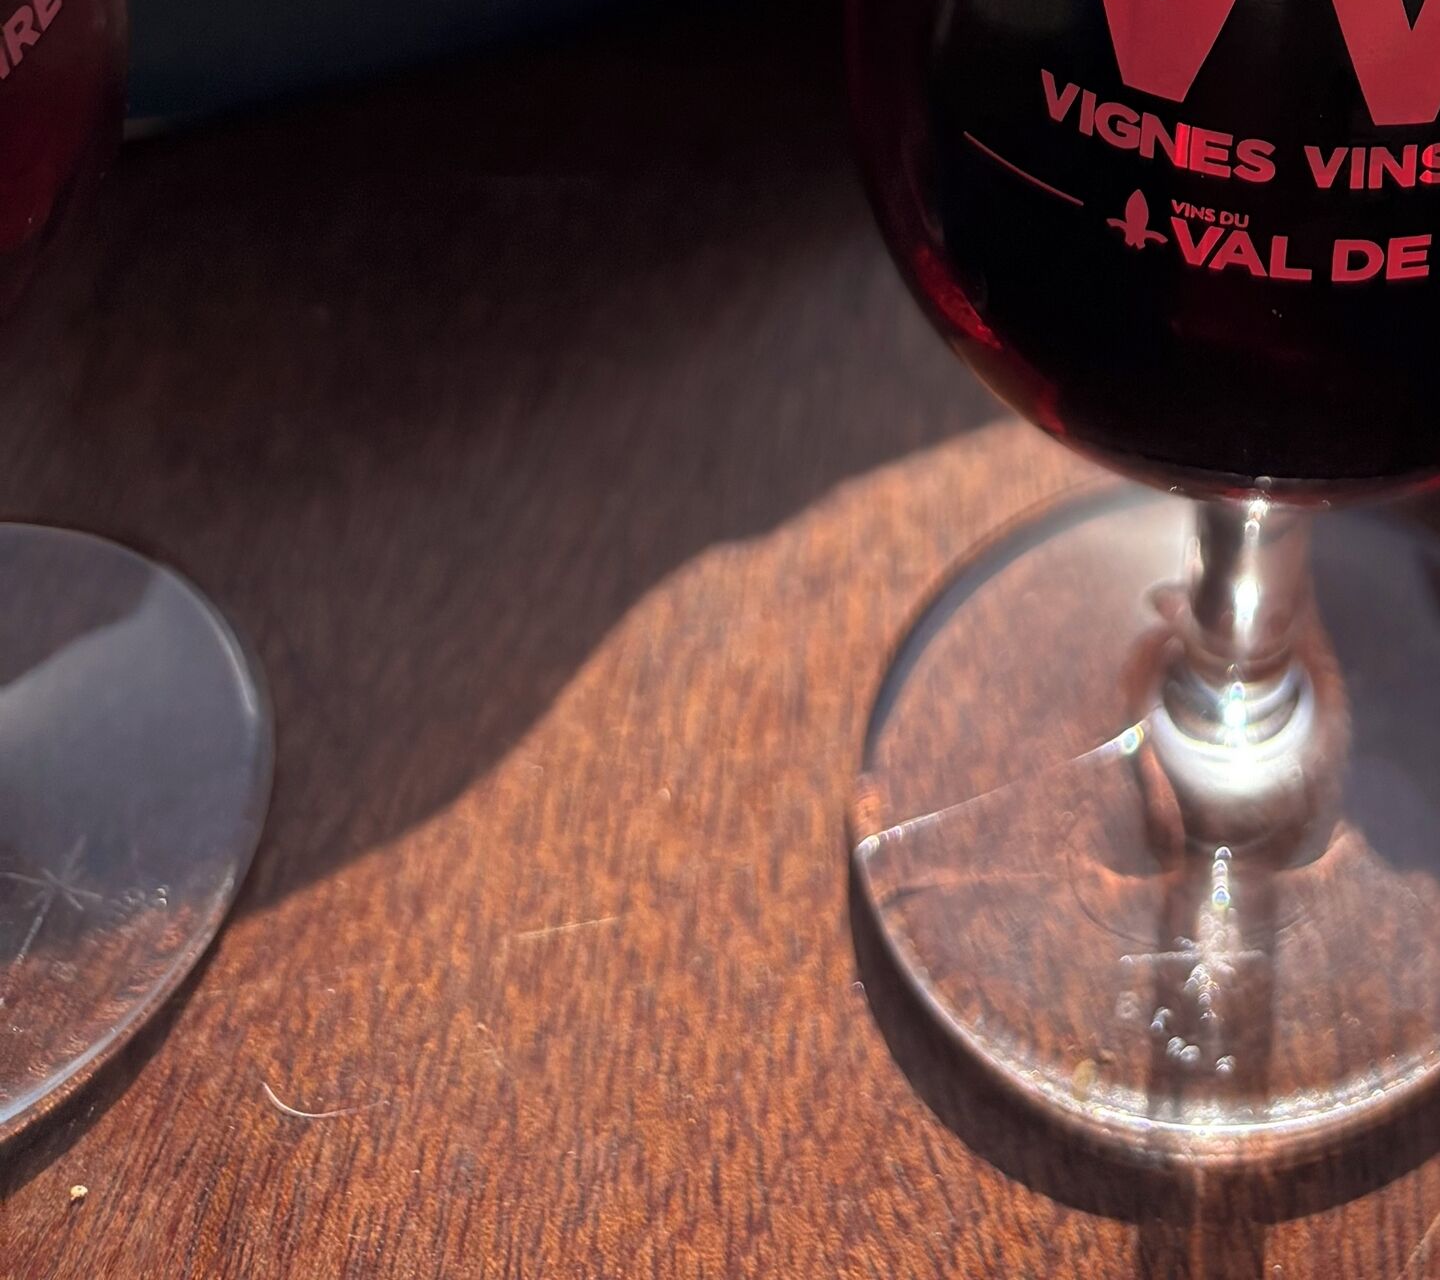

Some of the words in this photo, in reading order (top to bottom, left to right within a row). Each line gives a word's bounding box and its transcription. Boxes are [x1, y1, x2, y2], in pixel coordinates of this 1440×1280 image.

[1041, 68, 1277, 183] VIGNES
[1171, 198, 1216, 223] VINS
[1219, 210, 1250, 228] DU
[1170, 215, 1313, 281] VAL
[1331, 234, 1432, 283] DE
